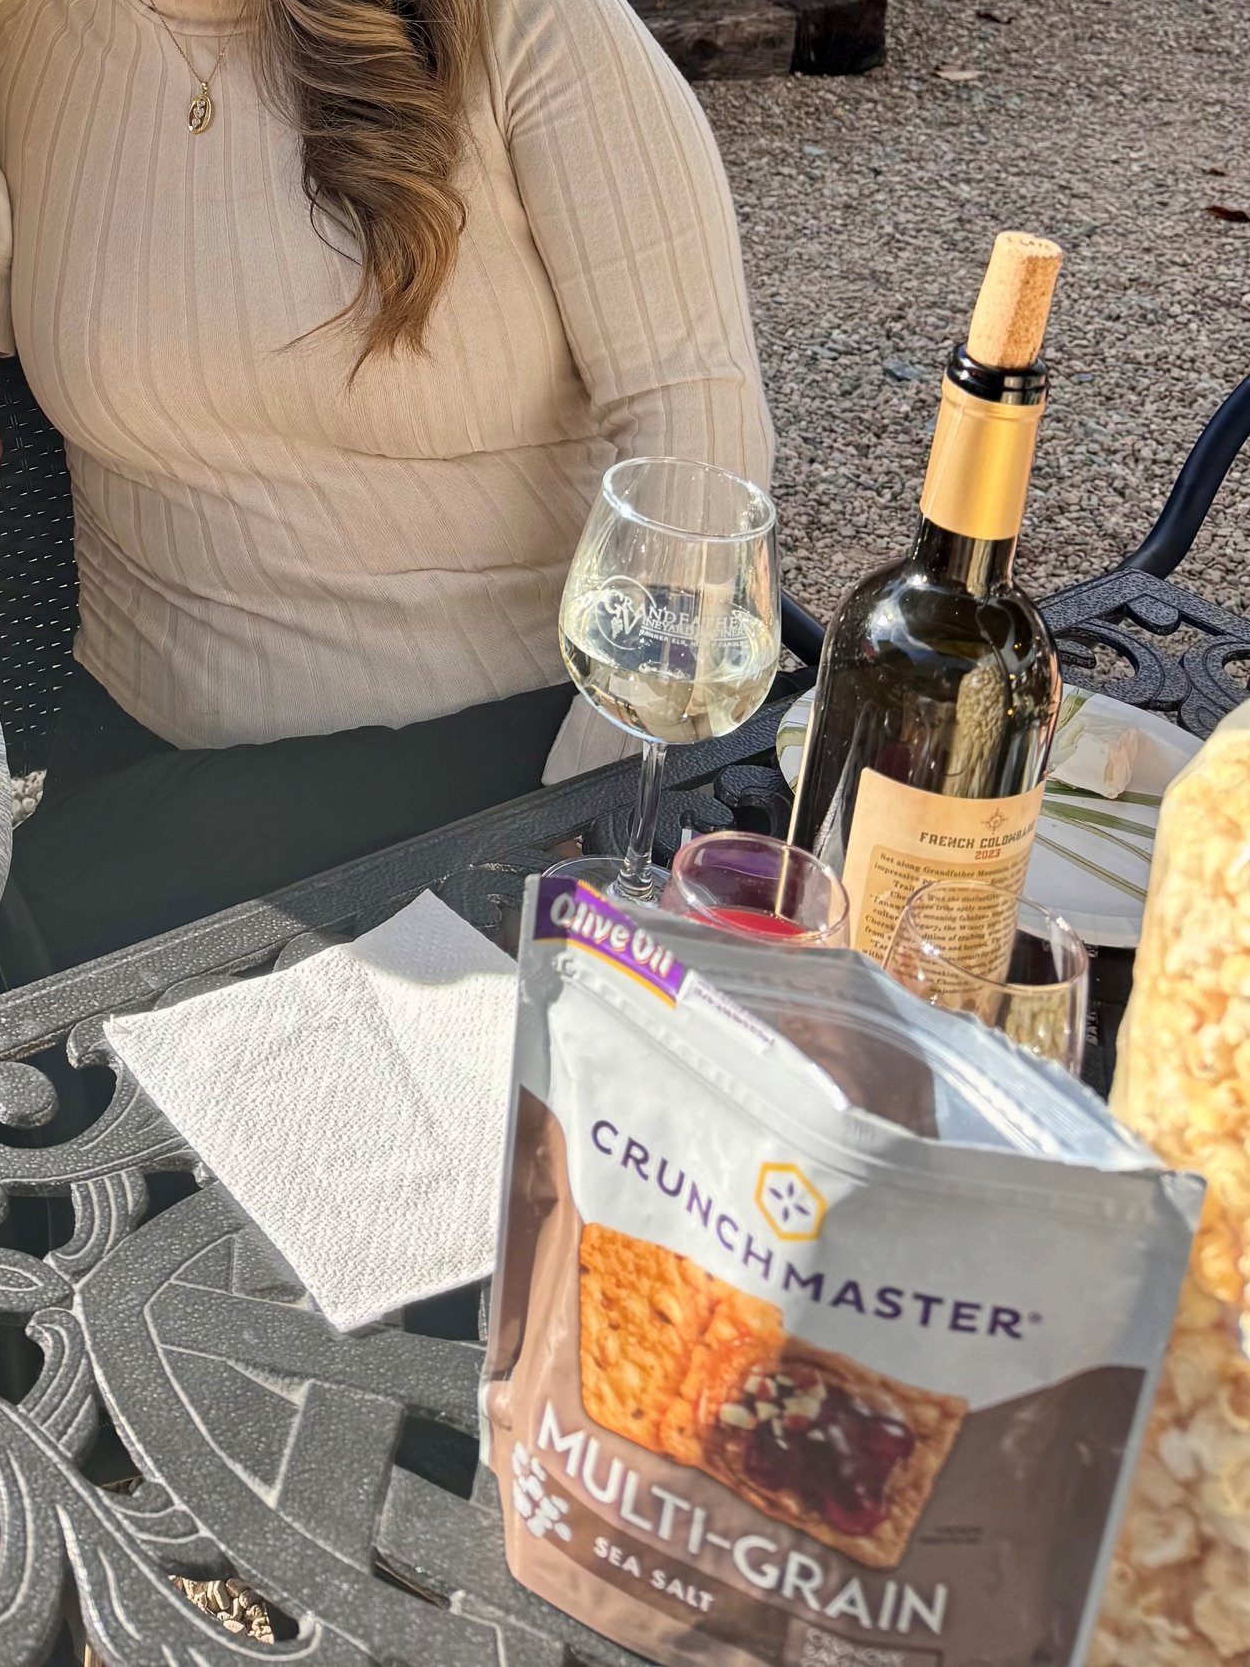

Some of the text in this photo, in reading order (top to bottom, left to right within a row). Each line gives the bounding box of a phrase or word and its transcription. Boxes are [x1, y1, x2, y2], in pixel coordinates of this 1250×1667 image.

[919, 832, 975, 849] FRENCH
[974, 848, 1002, 861] 2023
[874, 861, 920, 882] impressive
[879, 852, 894, 864] Set
[896, 858, 921, 872] along
[923, 865, 975, 878] Grandfather
[892, 879, 915, 892] Trail
[865, 914, 895, 931] Cherok
[873, 907, 900, 921] cultur
[550, 892, 674, 977] Olive Oil
[537, 1399, 947, 1634] MULTI-GRAIN
[592, 1535, 715, 1613] SEA SALT
